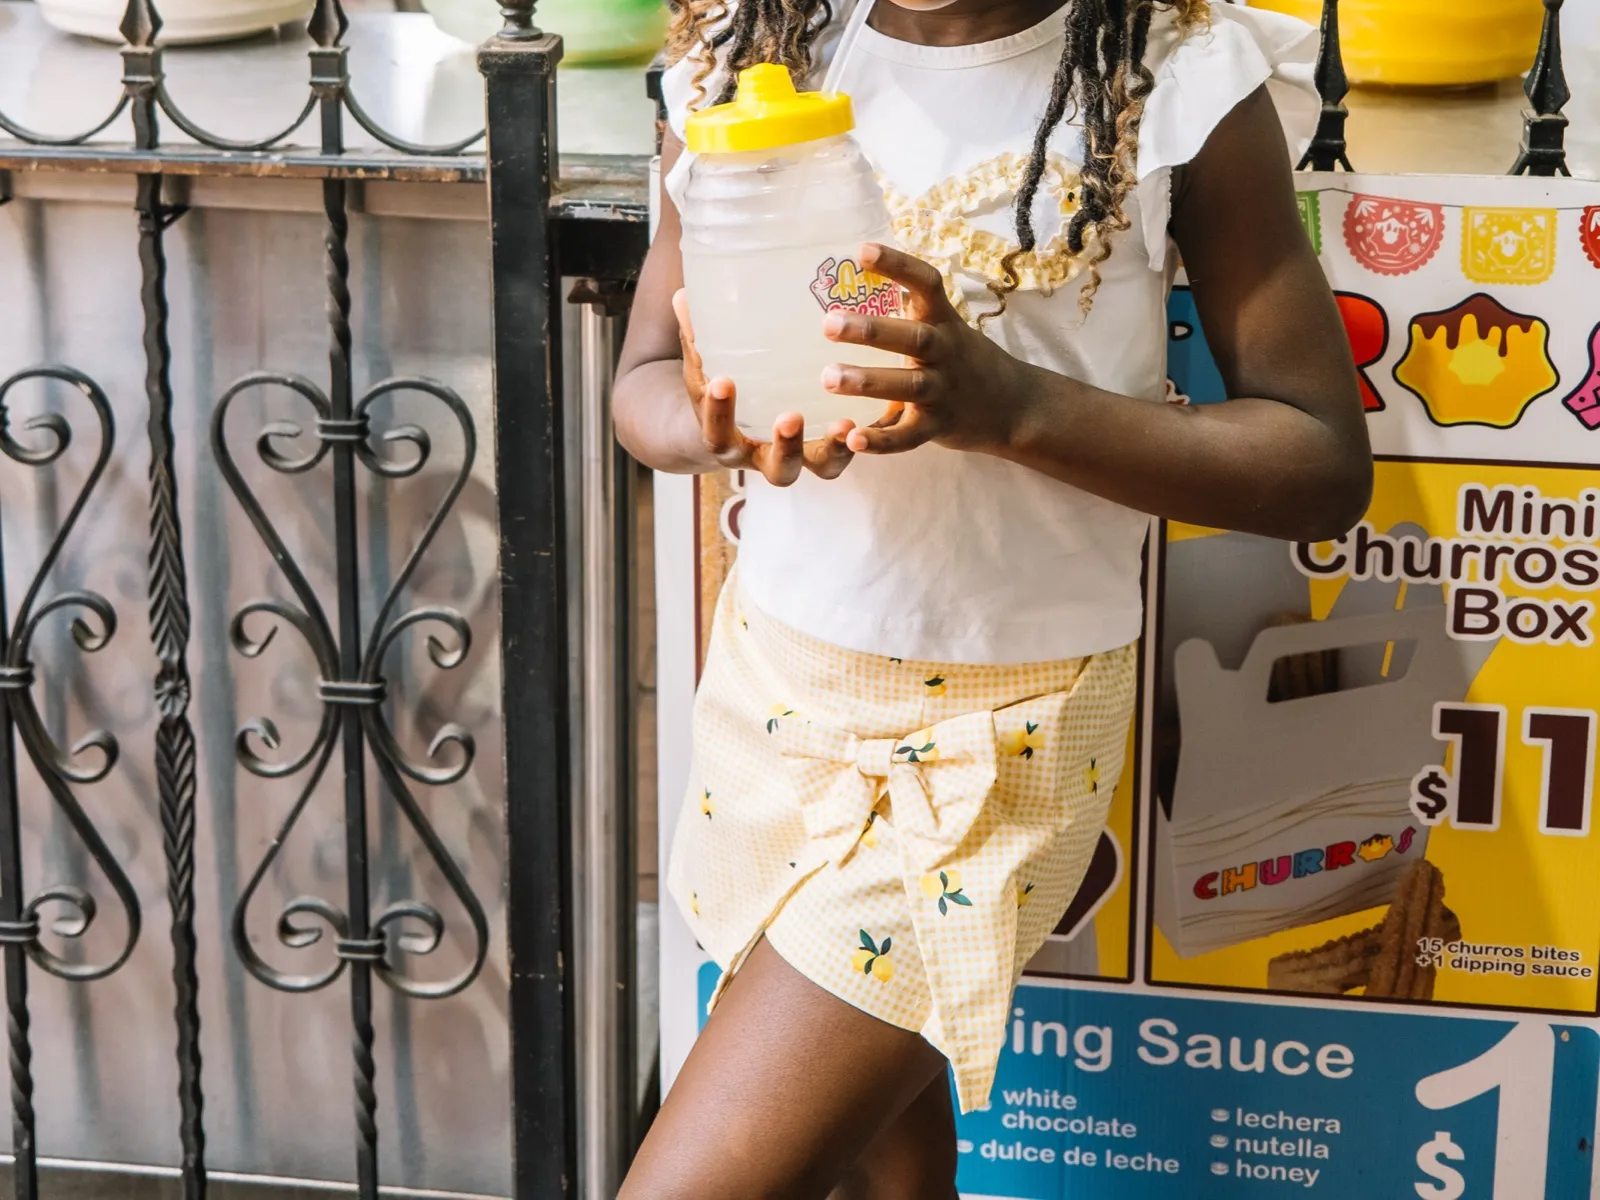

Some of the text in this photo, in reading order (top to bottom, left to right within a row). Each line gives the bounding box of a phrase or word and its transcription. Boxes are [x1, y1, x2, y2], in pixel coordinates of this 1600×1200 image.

[1462, 487, 1597, 539] Mini
[1294, 524, 1600, 587] Churros
[1450, 585, 1590, 642] Box
[1417, 937, 1581, 962] 15 churros bites
[1450, 955, 1526, 976] dipping
[1531, 963, 1593, 978] sauce
[1000, 1007, 1355, 1079] ing Sauce
[1002, 1087, 1078, 1110] white
[1001, 1111, 1137, 1138] chocolate
[1236, 1107, 1341, 1134] lechera
[979, 1139, 1180, 1173] dulce de leche
[1235, 1134, 1330, 1160] nutella
[1236, 1159, 1320, 1187] honey
